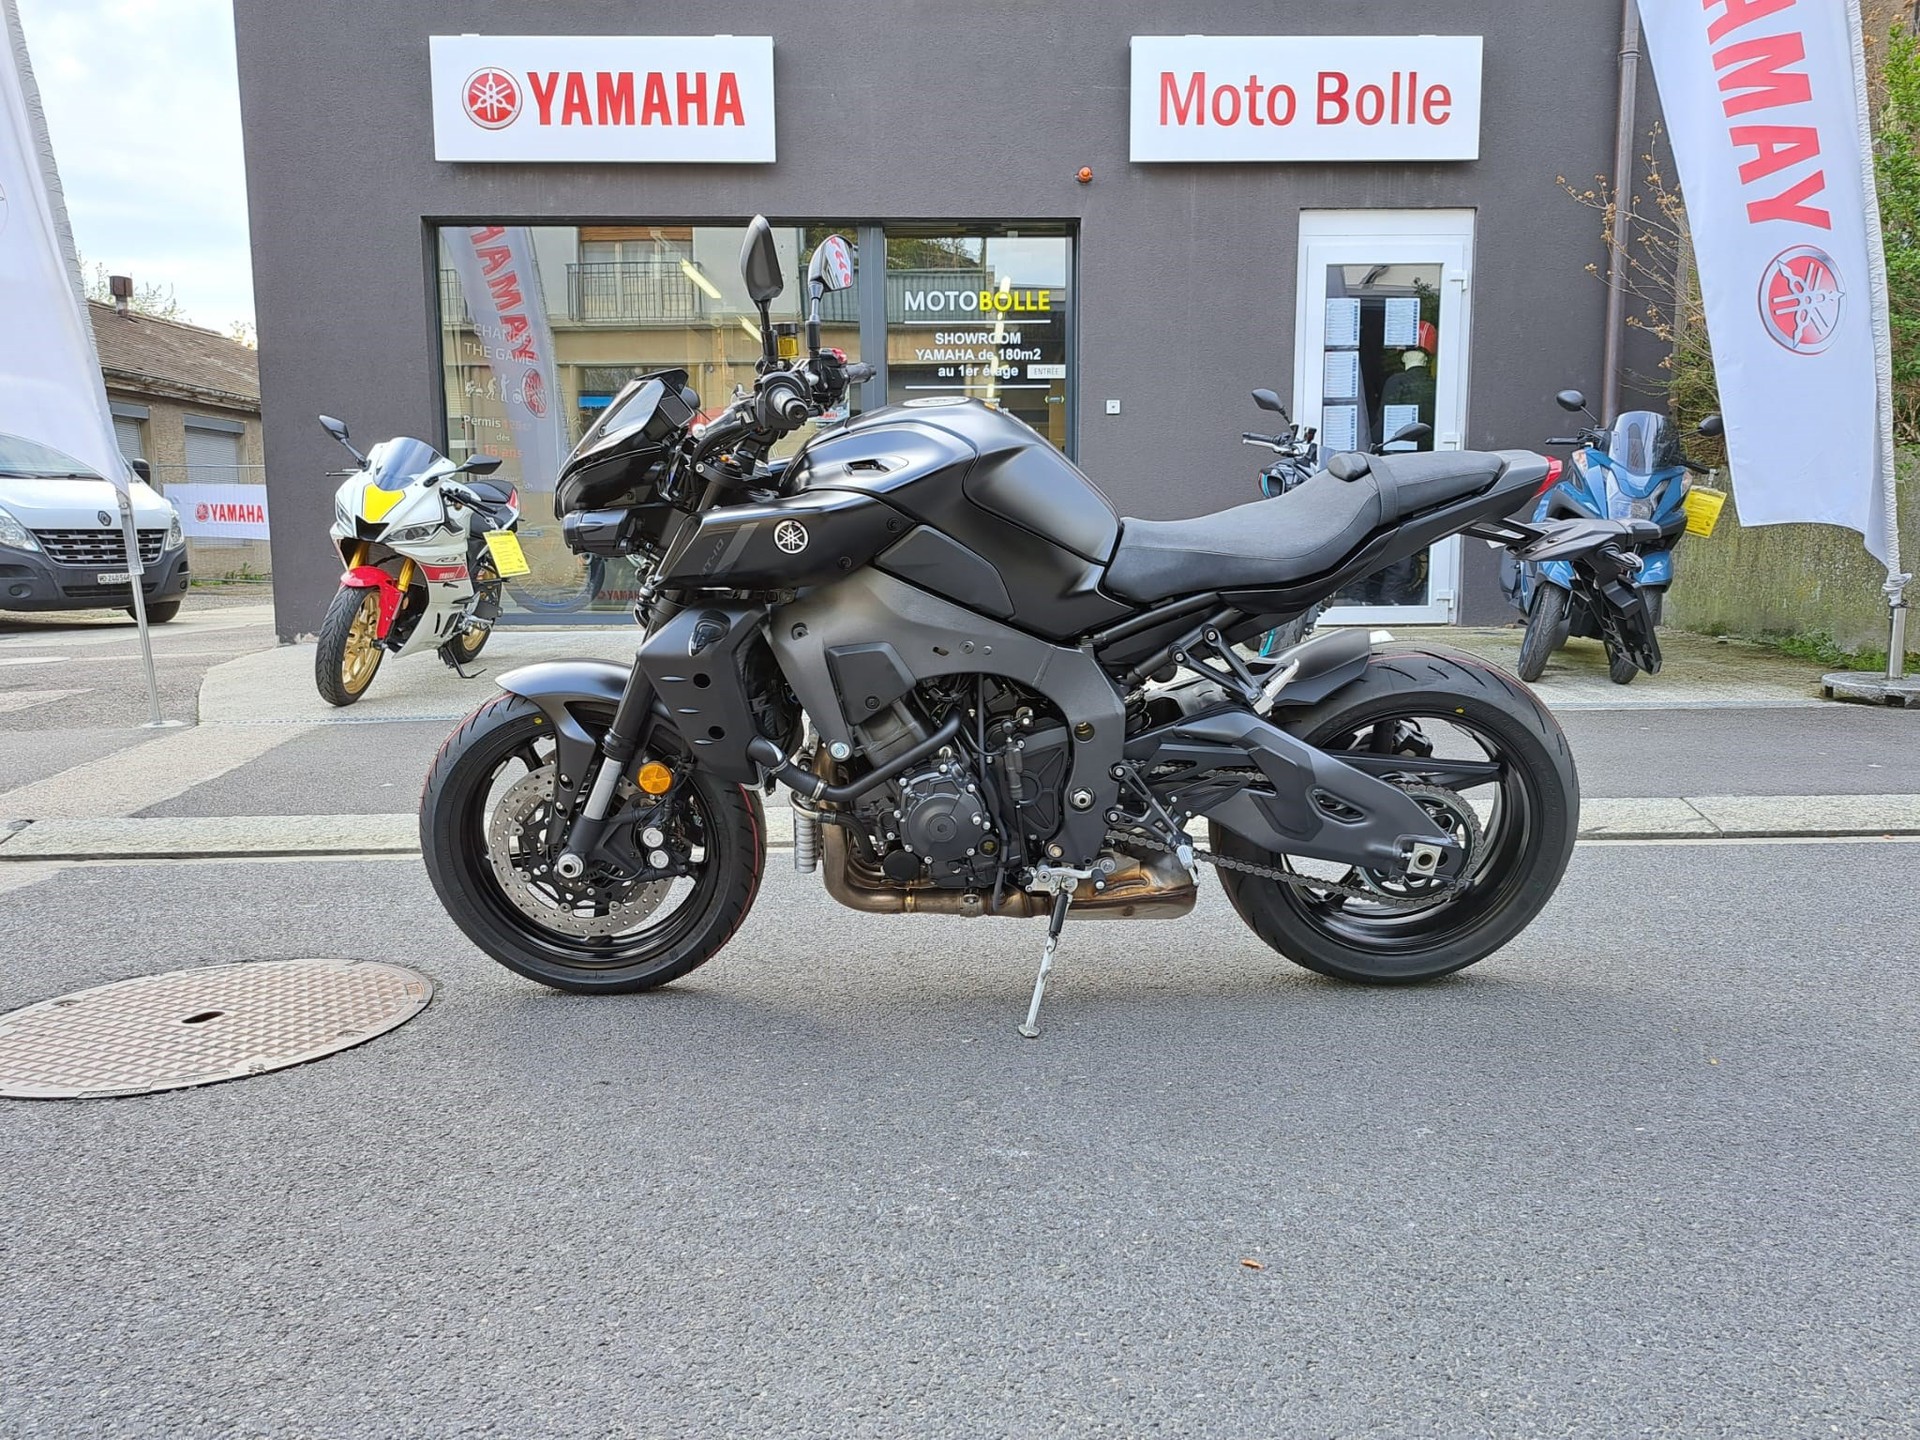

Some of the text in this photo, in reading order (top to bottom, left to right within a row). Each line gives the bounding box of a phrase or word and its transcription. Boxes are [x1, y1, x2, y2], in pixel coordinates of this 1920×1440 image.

[527, 72, 745, 126] YAMAHA
[1160, 71, 1452, 126] Moto Bolle
[904, 290, 1051, 311] MOTOBOLLE
[935, 332, 1021, 344] SHOWROOM
[464, 342, 492, 359] THE
[916, 348, 1041, 360] YAMAHA de 180m2
[938, 364, 1019, 379] au 1er éage
[463, 415, 502, 428] Permis
[210, 504, 265, 523] YAMAHA
